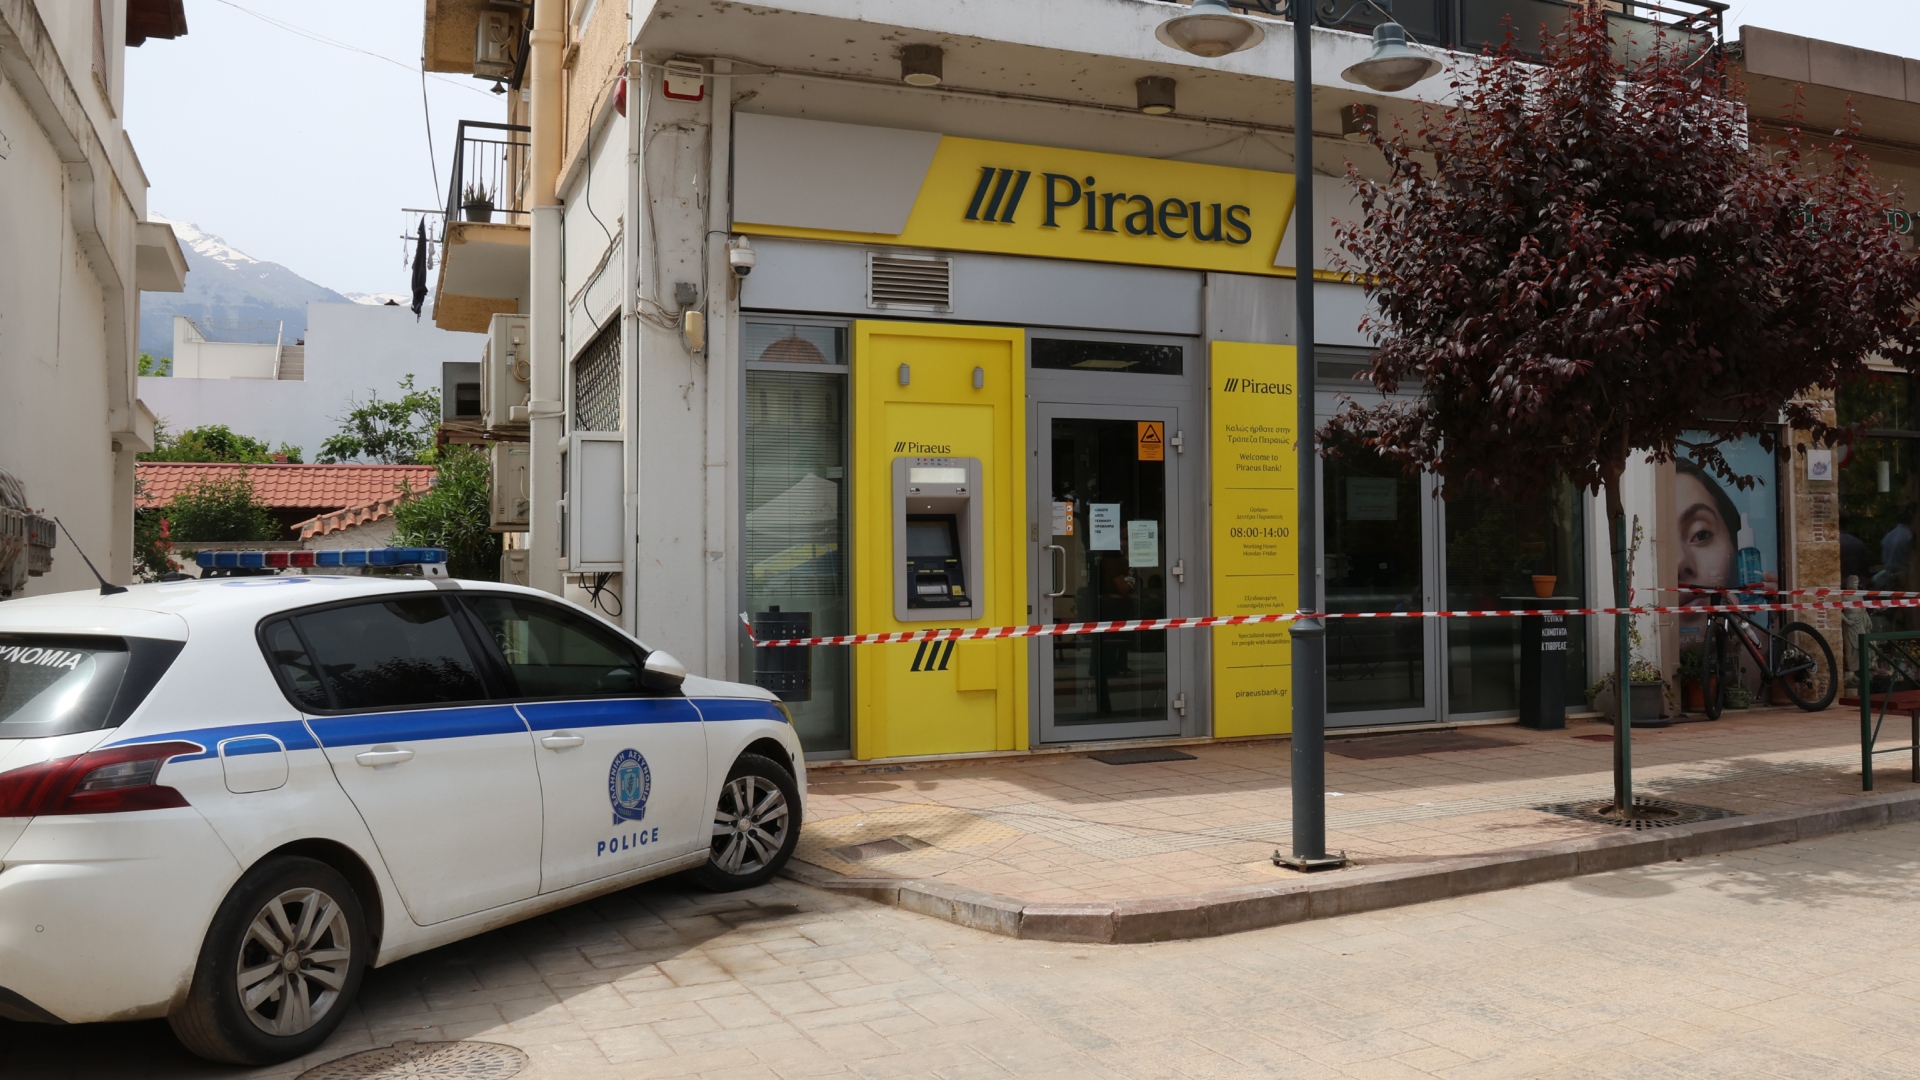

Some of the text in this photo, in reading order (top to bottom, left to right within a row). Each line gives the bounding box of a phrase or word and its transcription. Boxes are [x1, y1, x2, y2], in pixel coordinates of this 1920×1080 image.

[1041, 172, 1252, 245] Piraeus
[1241, 378, 1293, 395] Piraeus
[1225, 424, 1249, 433] Καλώς
[908, 441, 951, 454] Piraeus
[1239, 453, 1279, 462] Welcome to
[1236, 464, 1282, 472] Piraeus Bank!
[0, 646, 82, 670] ΥΝΟΜΙΑ
[1235, 688, 1288, 699] piraeusbank.gr
[609, 750, 650, 807] ΕΛΛΗΝΙΚΗ ΑΣΤΥΝΟΜΙΑ
[597, 827, 659, 857] POLICE
